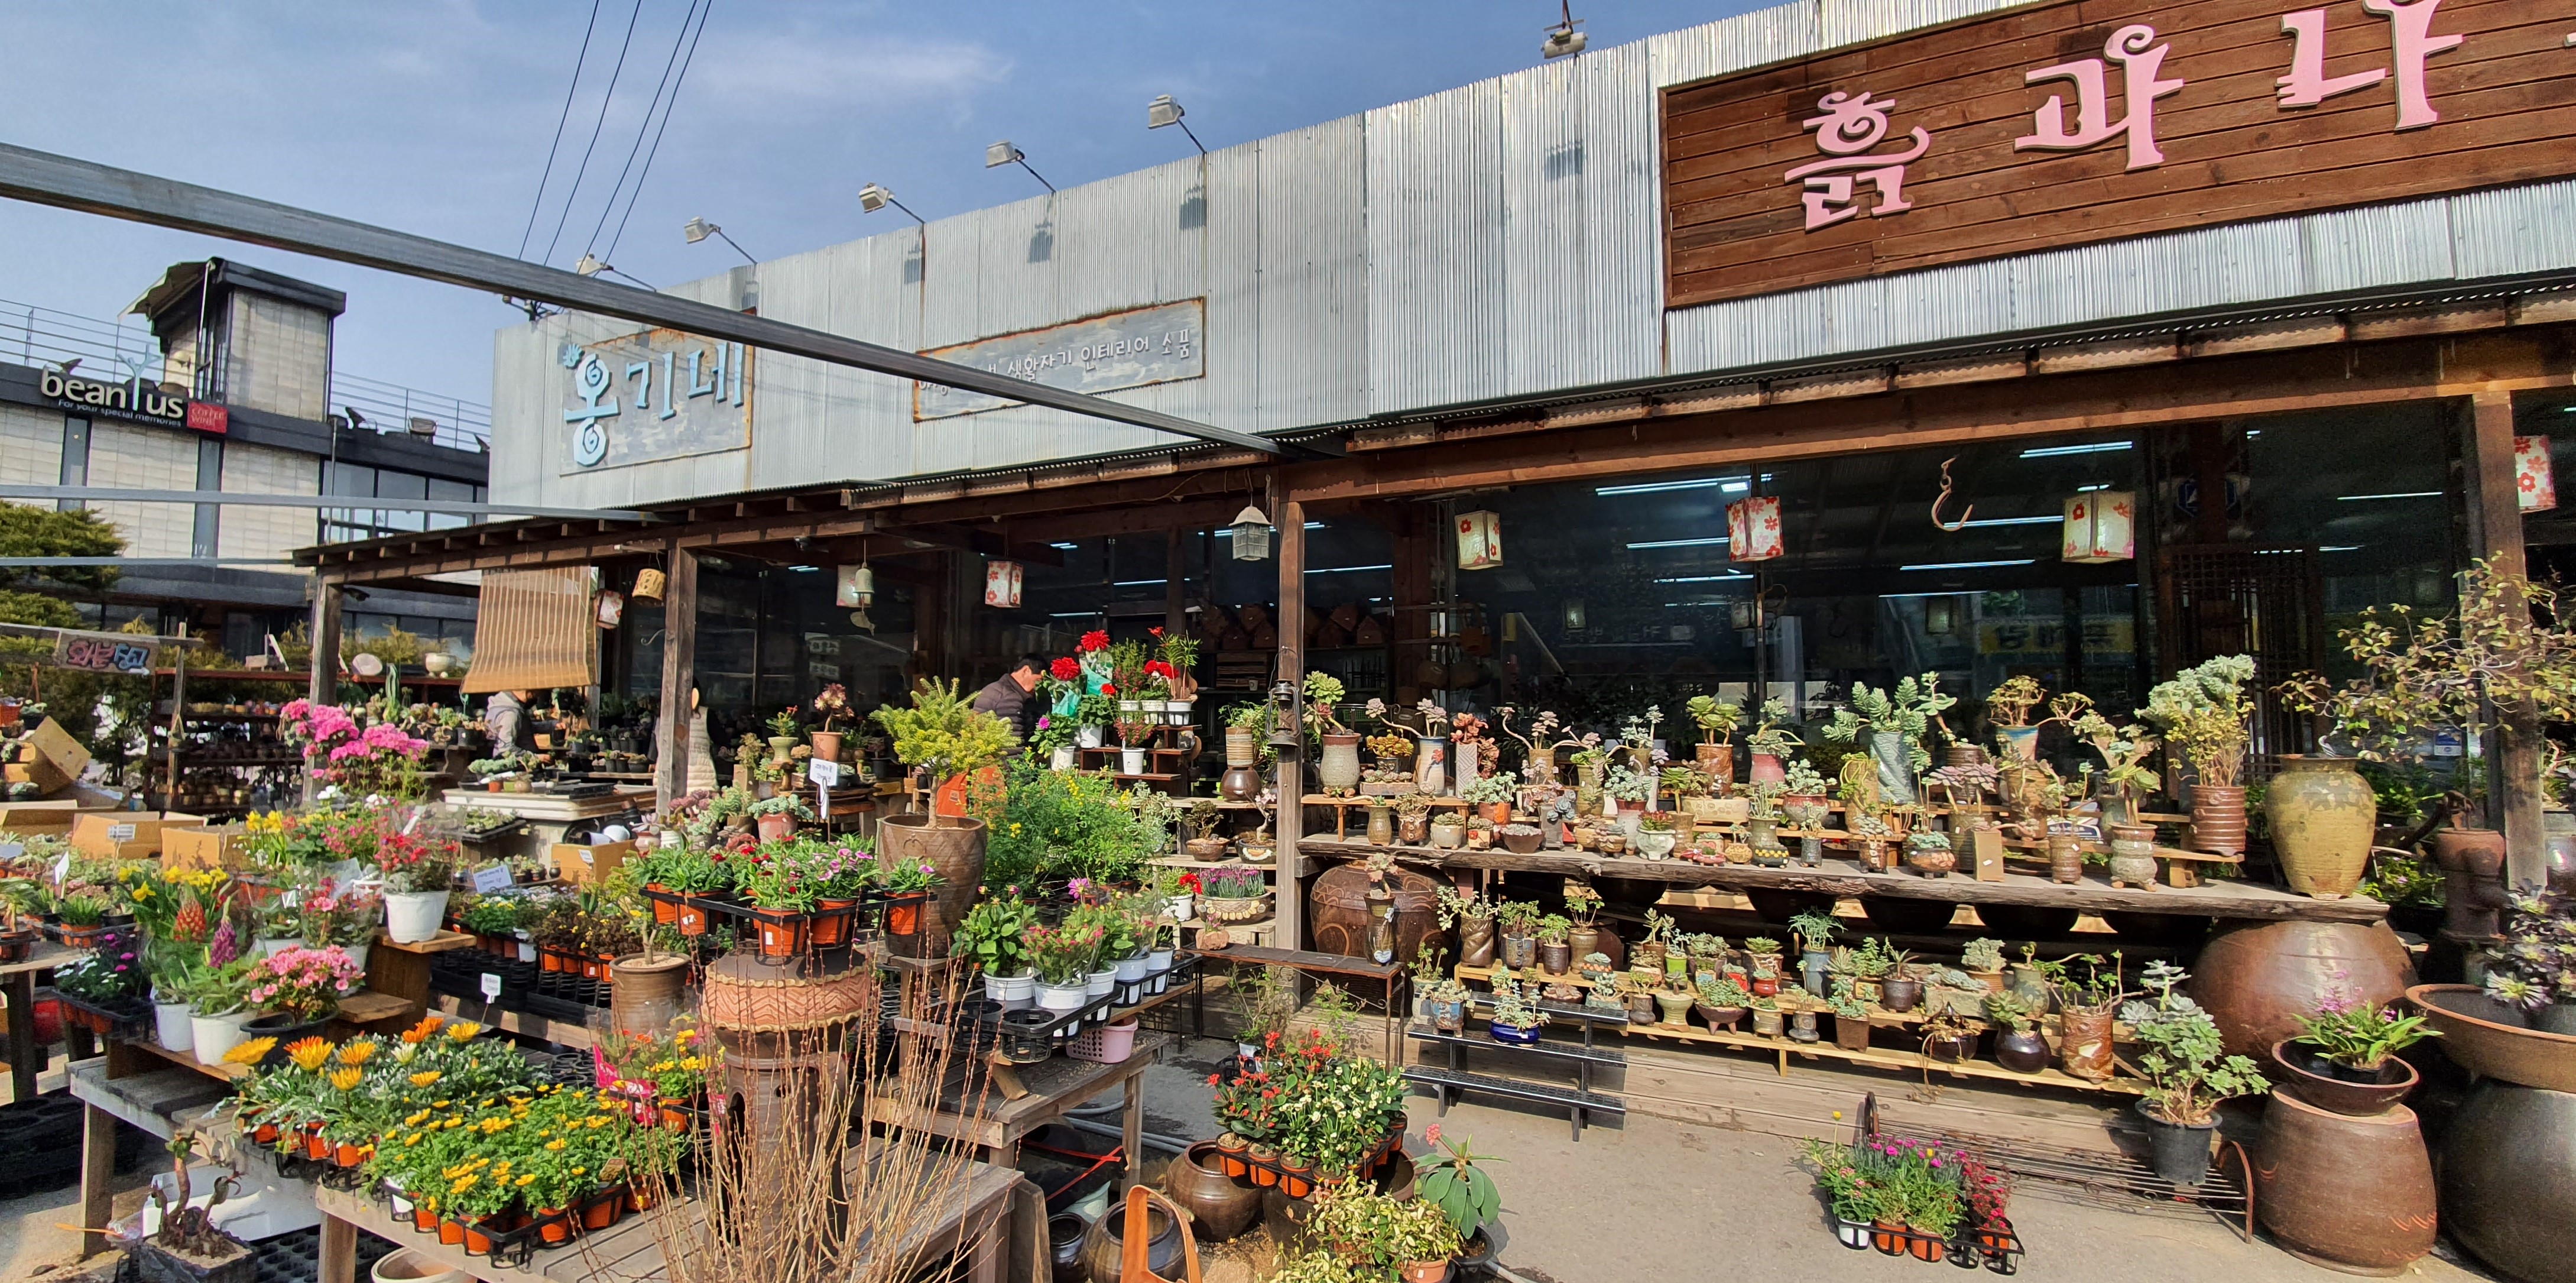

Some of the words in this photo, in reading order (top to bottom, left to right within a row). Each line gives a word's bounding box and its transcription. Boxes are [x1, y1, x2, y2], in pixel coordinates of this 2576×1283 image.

[1081, 336, 1149, 372] 인테리어
[1162, 328, 1190, 359] 소품
[59, 399, 74, 409] For
[76, 403, 98, 414] your
[100, 407, 133, 419] special
[135, 414, 181, 427] memories
[563, 342, 747, 466] 옹기네
